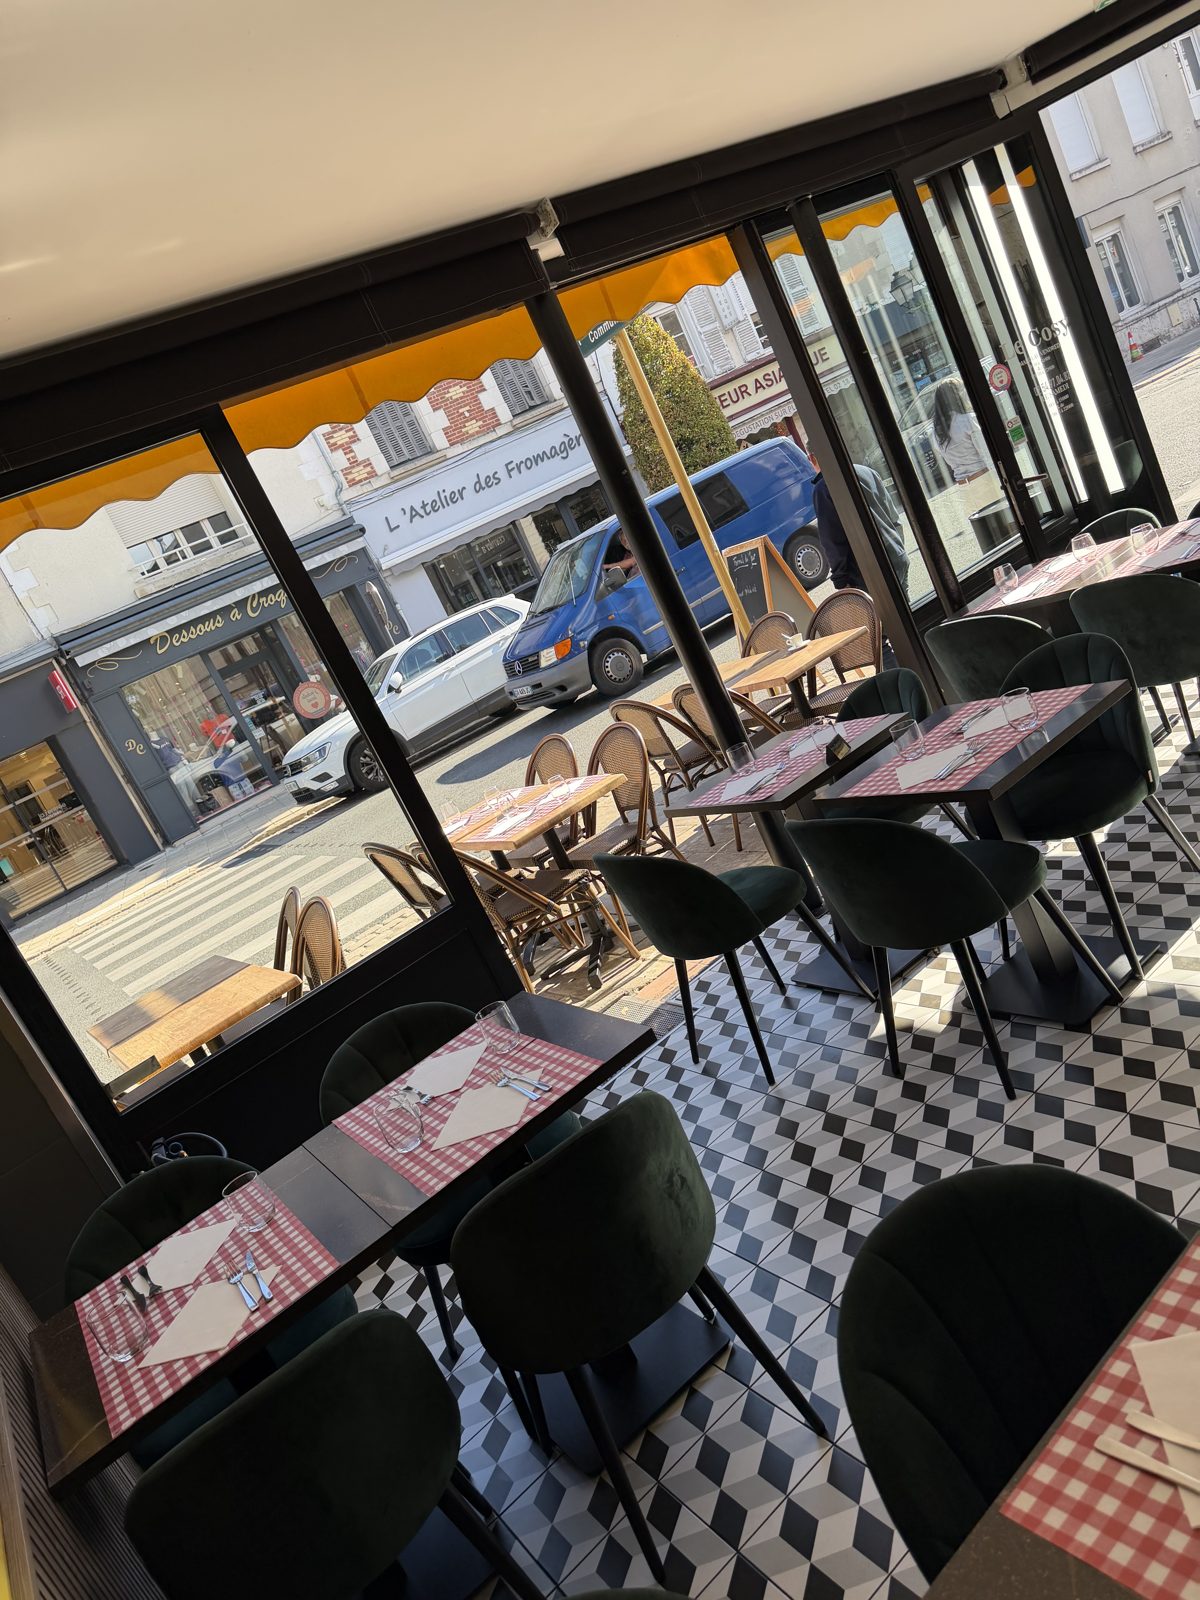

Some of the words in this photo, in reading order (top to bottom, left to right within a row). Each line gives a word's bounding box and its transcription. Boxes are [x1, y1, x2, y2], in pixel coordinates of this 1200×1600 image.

[588, 320, 620, 343] Commu
[1028, 319, 1069, 347] Cosy
[715, 387, 752, 409] EUR
[774, 408, 788, 420] SUR
[384, 486, 467, 533] L'Atelier
[472, 473, 501, 494] des
[149, 614, 225, 655] Dessous
[229, 603, 243, 622] à
